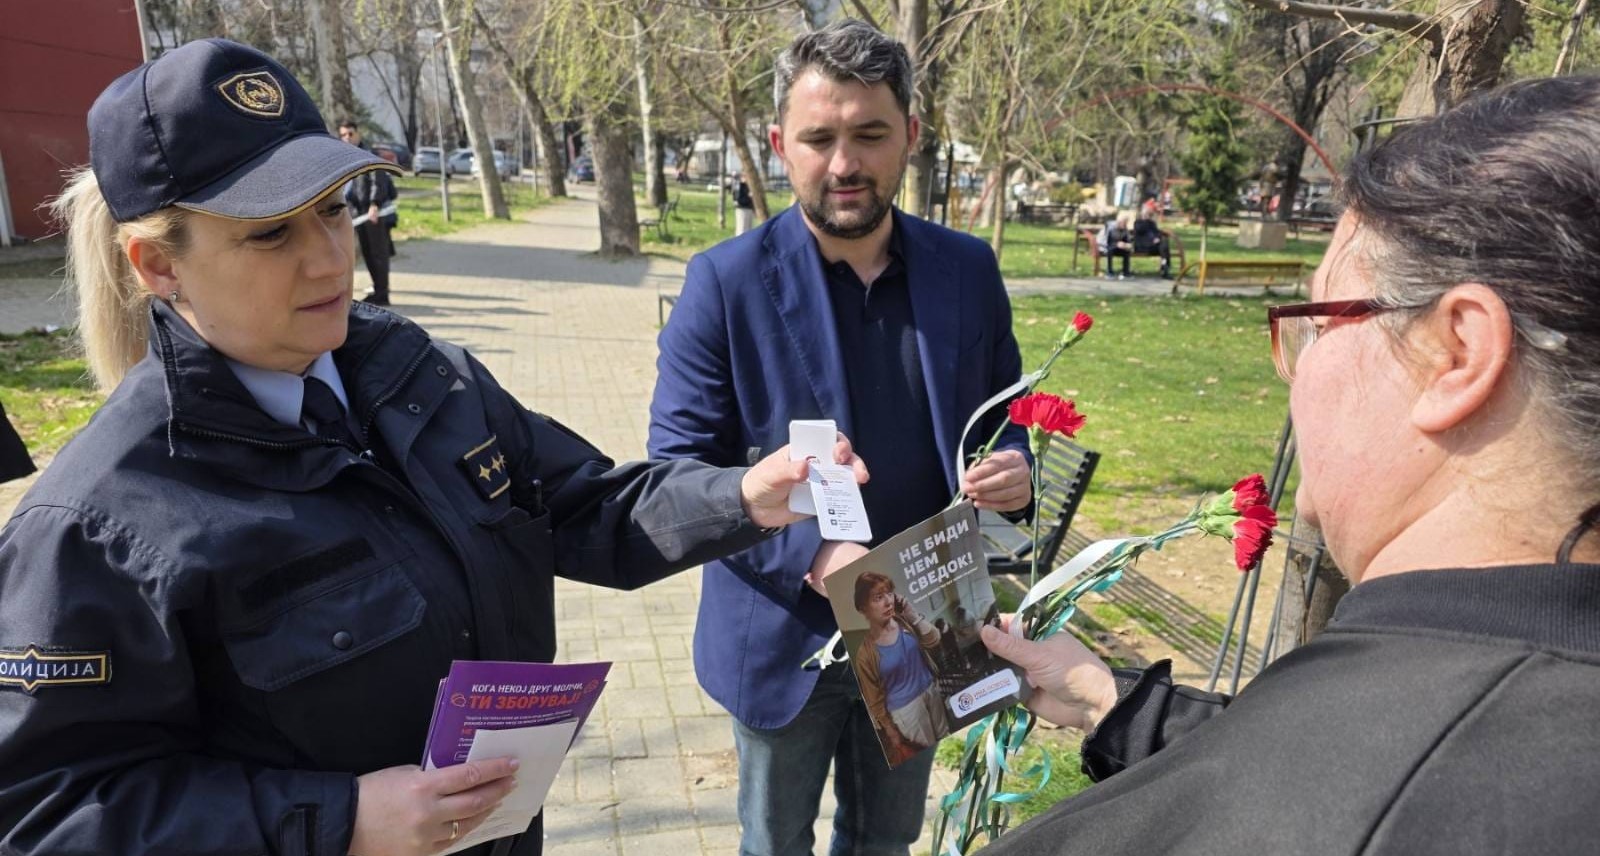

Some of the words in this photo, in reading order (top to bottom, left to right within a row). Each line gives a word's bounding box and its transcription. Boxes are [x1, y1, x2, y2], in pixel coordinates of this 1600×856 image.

[899, 543, 922, 564] НЕ
[924, 519, 969, 552] БИДИ
[904, 552, 939, 579] НЕМ
[908, 552, 974, 595] СВЕДОК!
[0, 662, 95, 678] ОЛИЦИЈА
[472, 684, 496, 693] КОГА
[498, 684, 525, 693] НЕКОЈ
[528, 684, 551, 694] ДРУГ
[470, 695, 492, 709] ТИ
[496, 692, 581, 709] ЗБОРУВАЈ!
